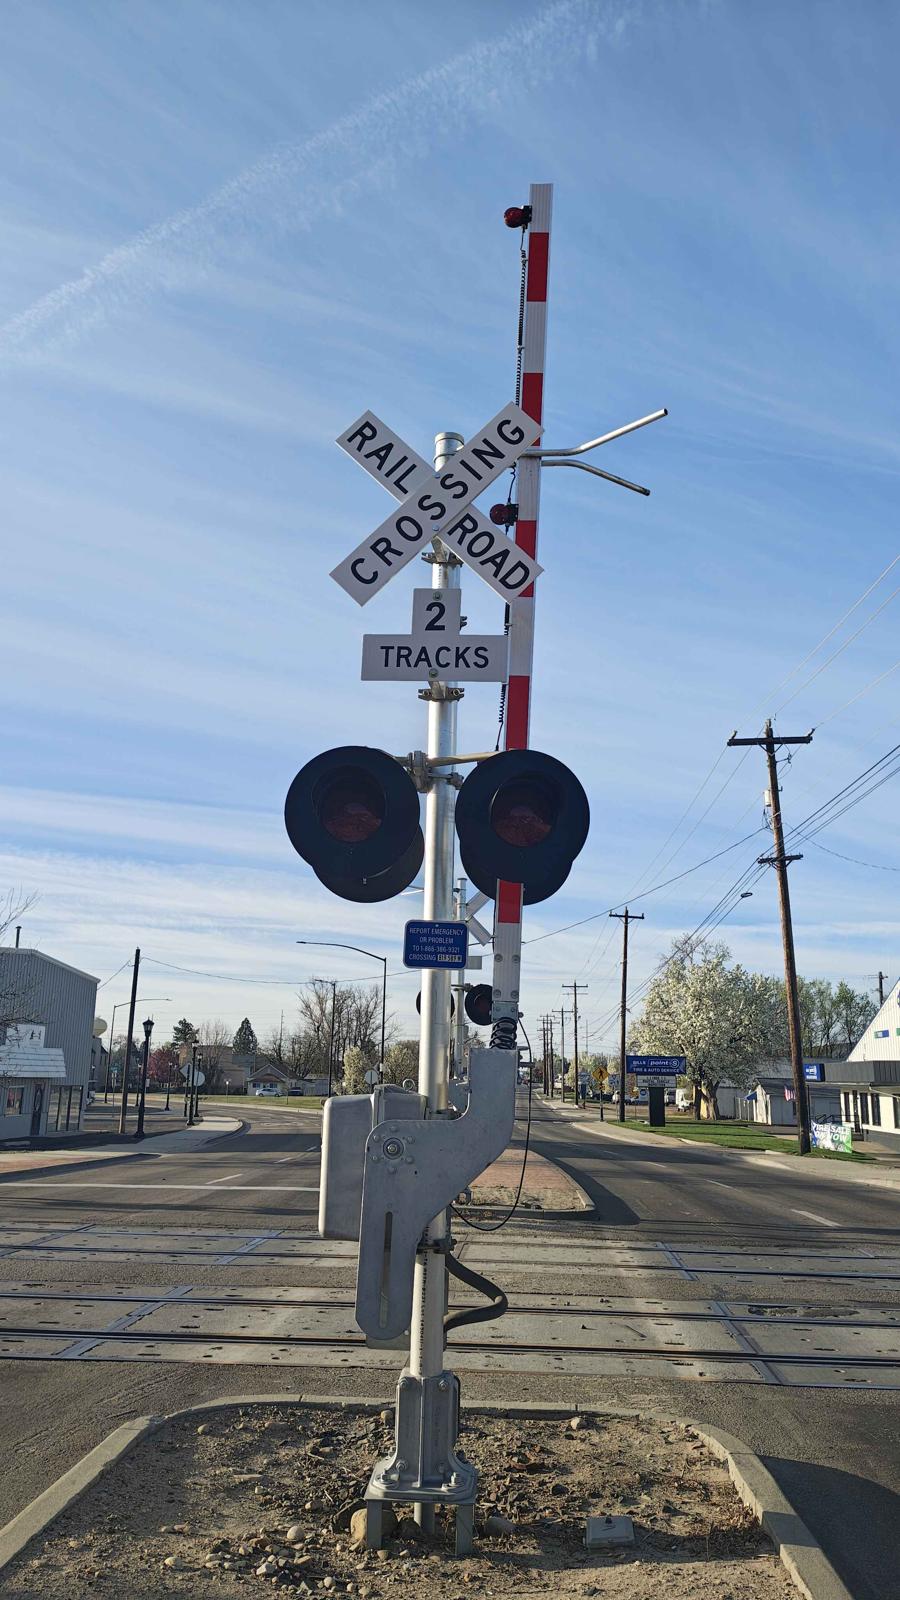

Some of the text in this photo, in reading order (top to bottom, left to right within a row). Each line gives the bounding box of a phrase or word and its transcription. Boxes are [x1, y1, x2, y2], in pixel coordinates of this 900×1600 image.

[346, 421, 417, 494] RAIL
[350, 418, 525, 585] CROSSING
[447, 513, 530, 590] ROAD
[424, 602, 446, 631] 2
[380, 646, 489, 669] TRACKS
[428, 936, 454, 944] PROBLEM
[431, 928, 464, 936] EMERGENCY
[408, 953, 436, 961] CROSSING
